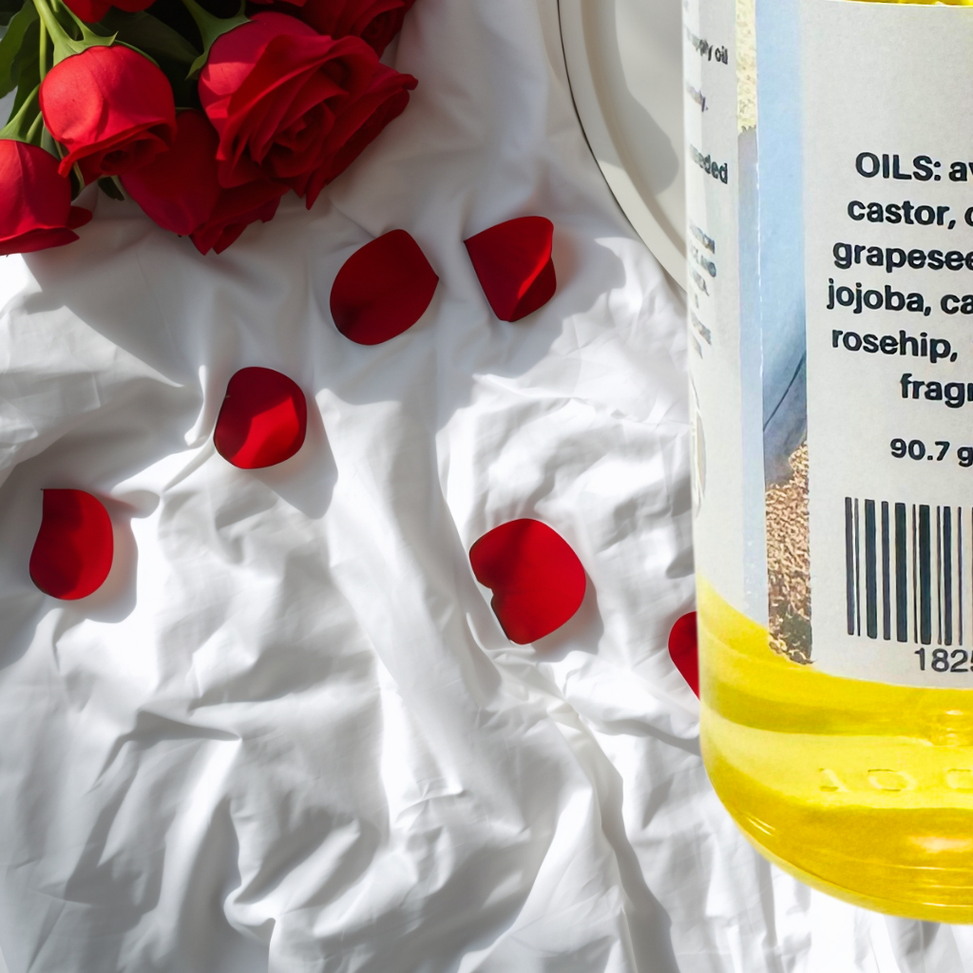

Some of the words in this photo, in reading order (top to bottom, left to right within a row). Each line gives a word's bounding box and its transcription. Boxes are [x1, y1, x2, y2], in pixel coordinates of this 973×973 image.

[714, 45, 728, 65] oil
[855, 152, 942, 181] OILS:
[847, 200, 956, 230] castor,
[827, 278, 932, 316] jojoba,
[832, 329, 958, 363] rosehip,
[890, 438, 950, 461] 90.7
[957, 445, 973, 467] g
